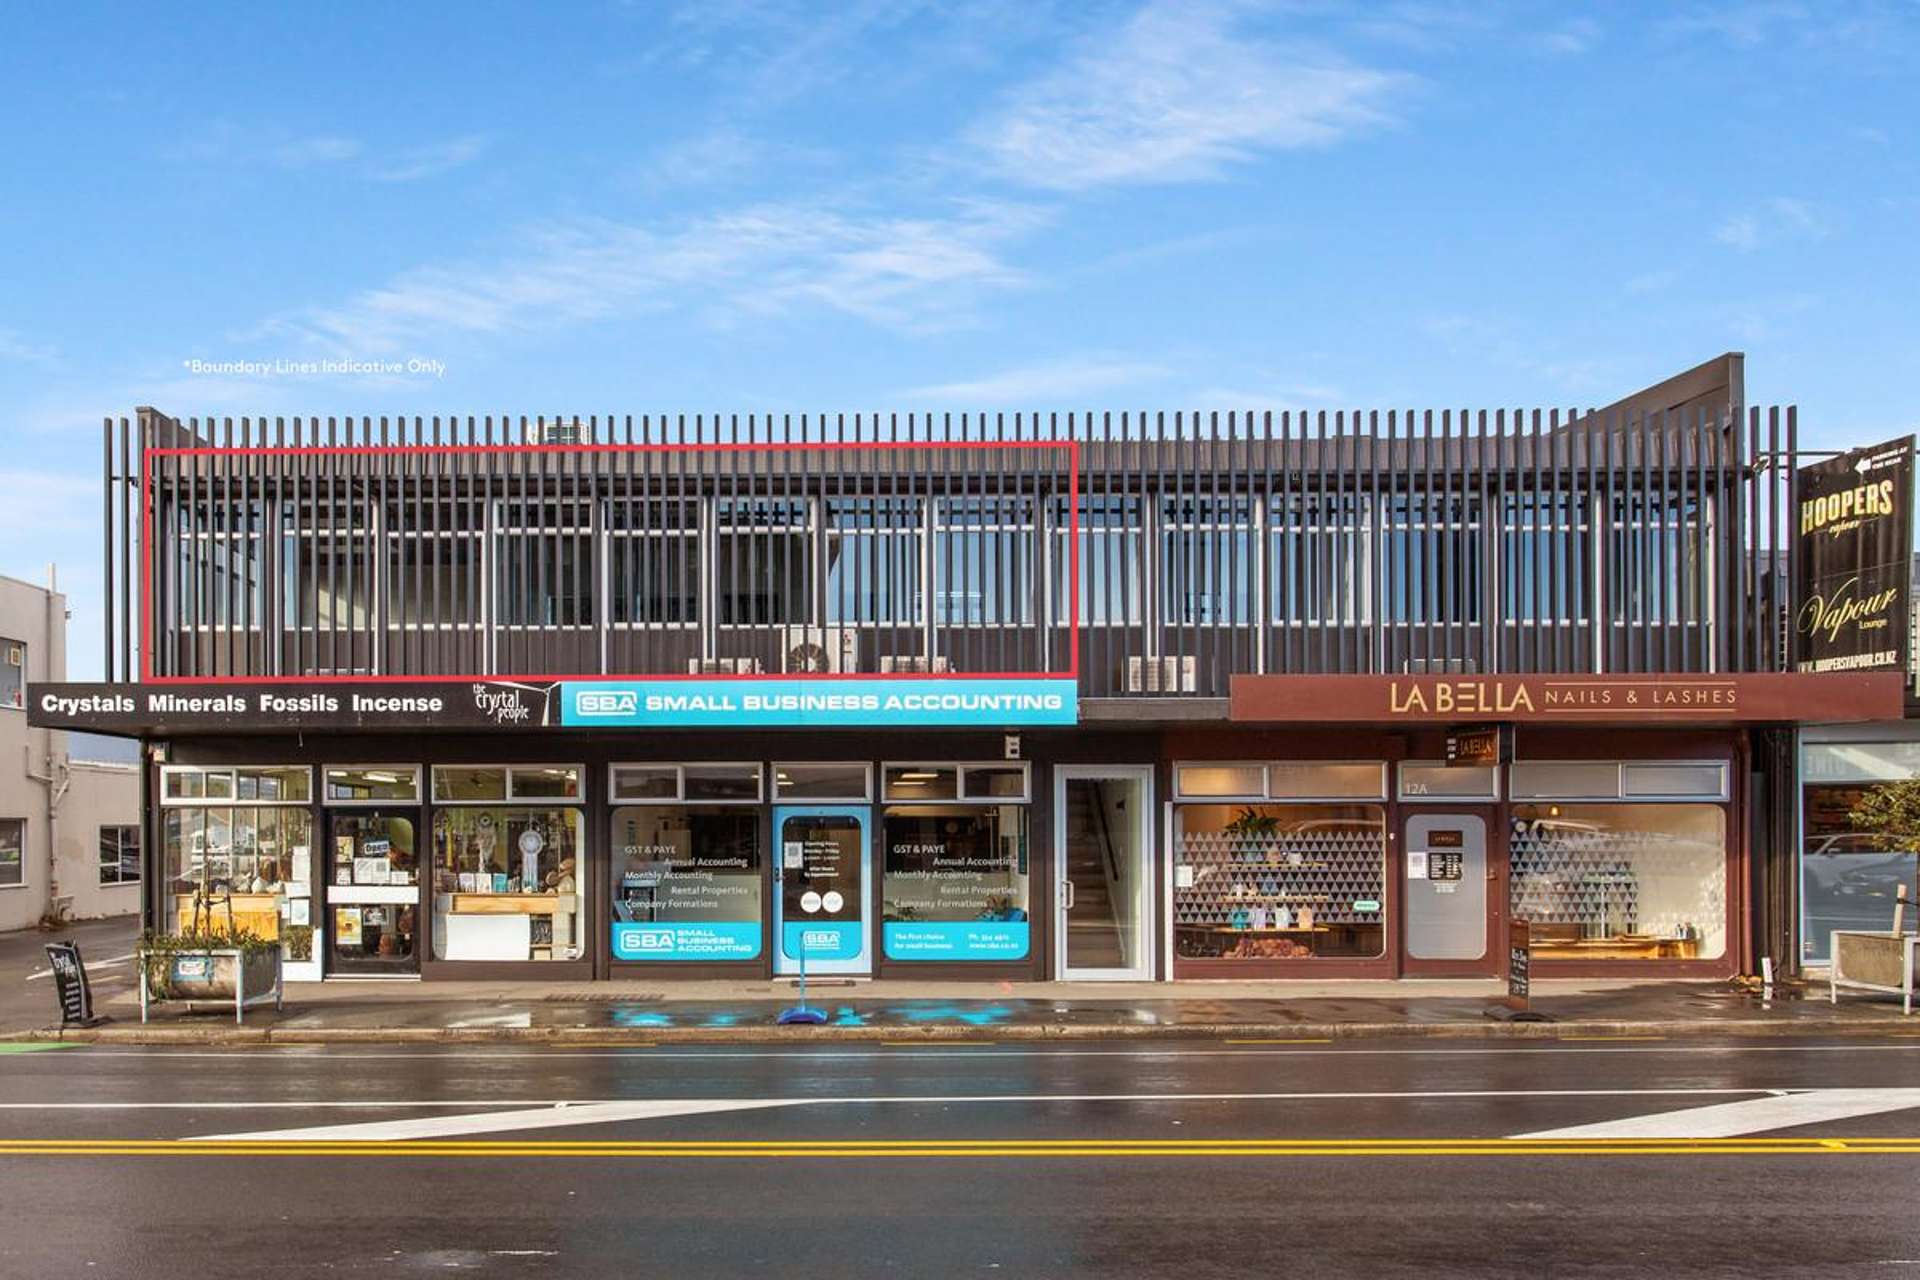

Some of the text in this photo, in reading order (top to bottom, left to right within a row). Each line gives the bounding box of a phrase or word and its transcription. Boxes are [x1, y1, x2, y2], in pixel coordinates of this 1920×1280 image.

[1801, 479, 1894, 537] HOOPERS
[1797, 577, 1898, 643] Vapour
[1858, 617, 1888, 630] Lounge
[472, 683, 487, 694] the
[475, 689, 520, 716] crystal
[1391, 682, 1535, 713] LA BELLA
[1545, 690, 1737, 704] NAILS & LASHES
[41, 694, 443, 716] Crystals Minerals Fossils Incense
[580, 693, 1063, 713] SBA SMALL BUSINESS ACCOUNTING
[497, 705, 529, 724] people
[1406, 783, 1428, 795] 12A
[653, 845, 676, 854] PAYE
[893, 845, 945, 854] GST & PAYE
[664, 857, 748, 868] Annual Accounting
[933, 857, 1018, 868] Annual Accounting
[625, 871, 713, 881] Monthly Accounting
[894, 871, 983, 881] Monthly Accounting
[671, 886, 748, 896] Rental Properties
[940, 886, 1018, 896] Rental Properties
[625, 900, 718, 910] Company Formations
[894, 899, 988, 909] Company Formations
[624, 933, 673, 949] SBA
[677, 937, 735, 945] BUSINESS
[805, 933, 838, 945] SBA
[677, 945, 752, 953] ACCOUNTING
